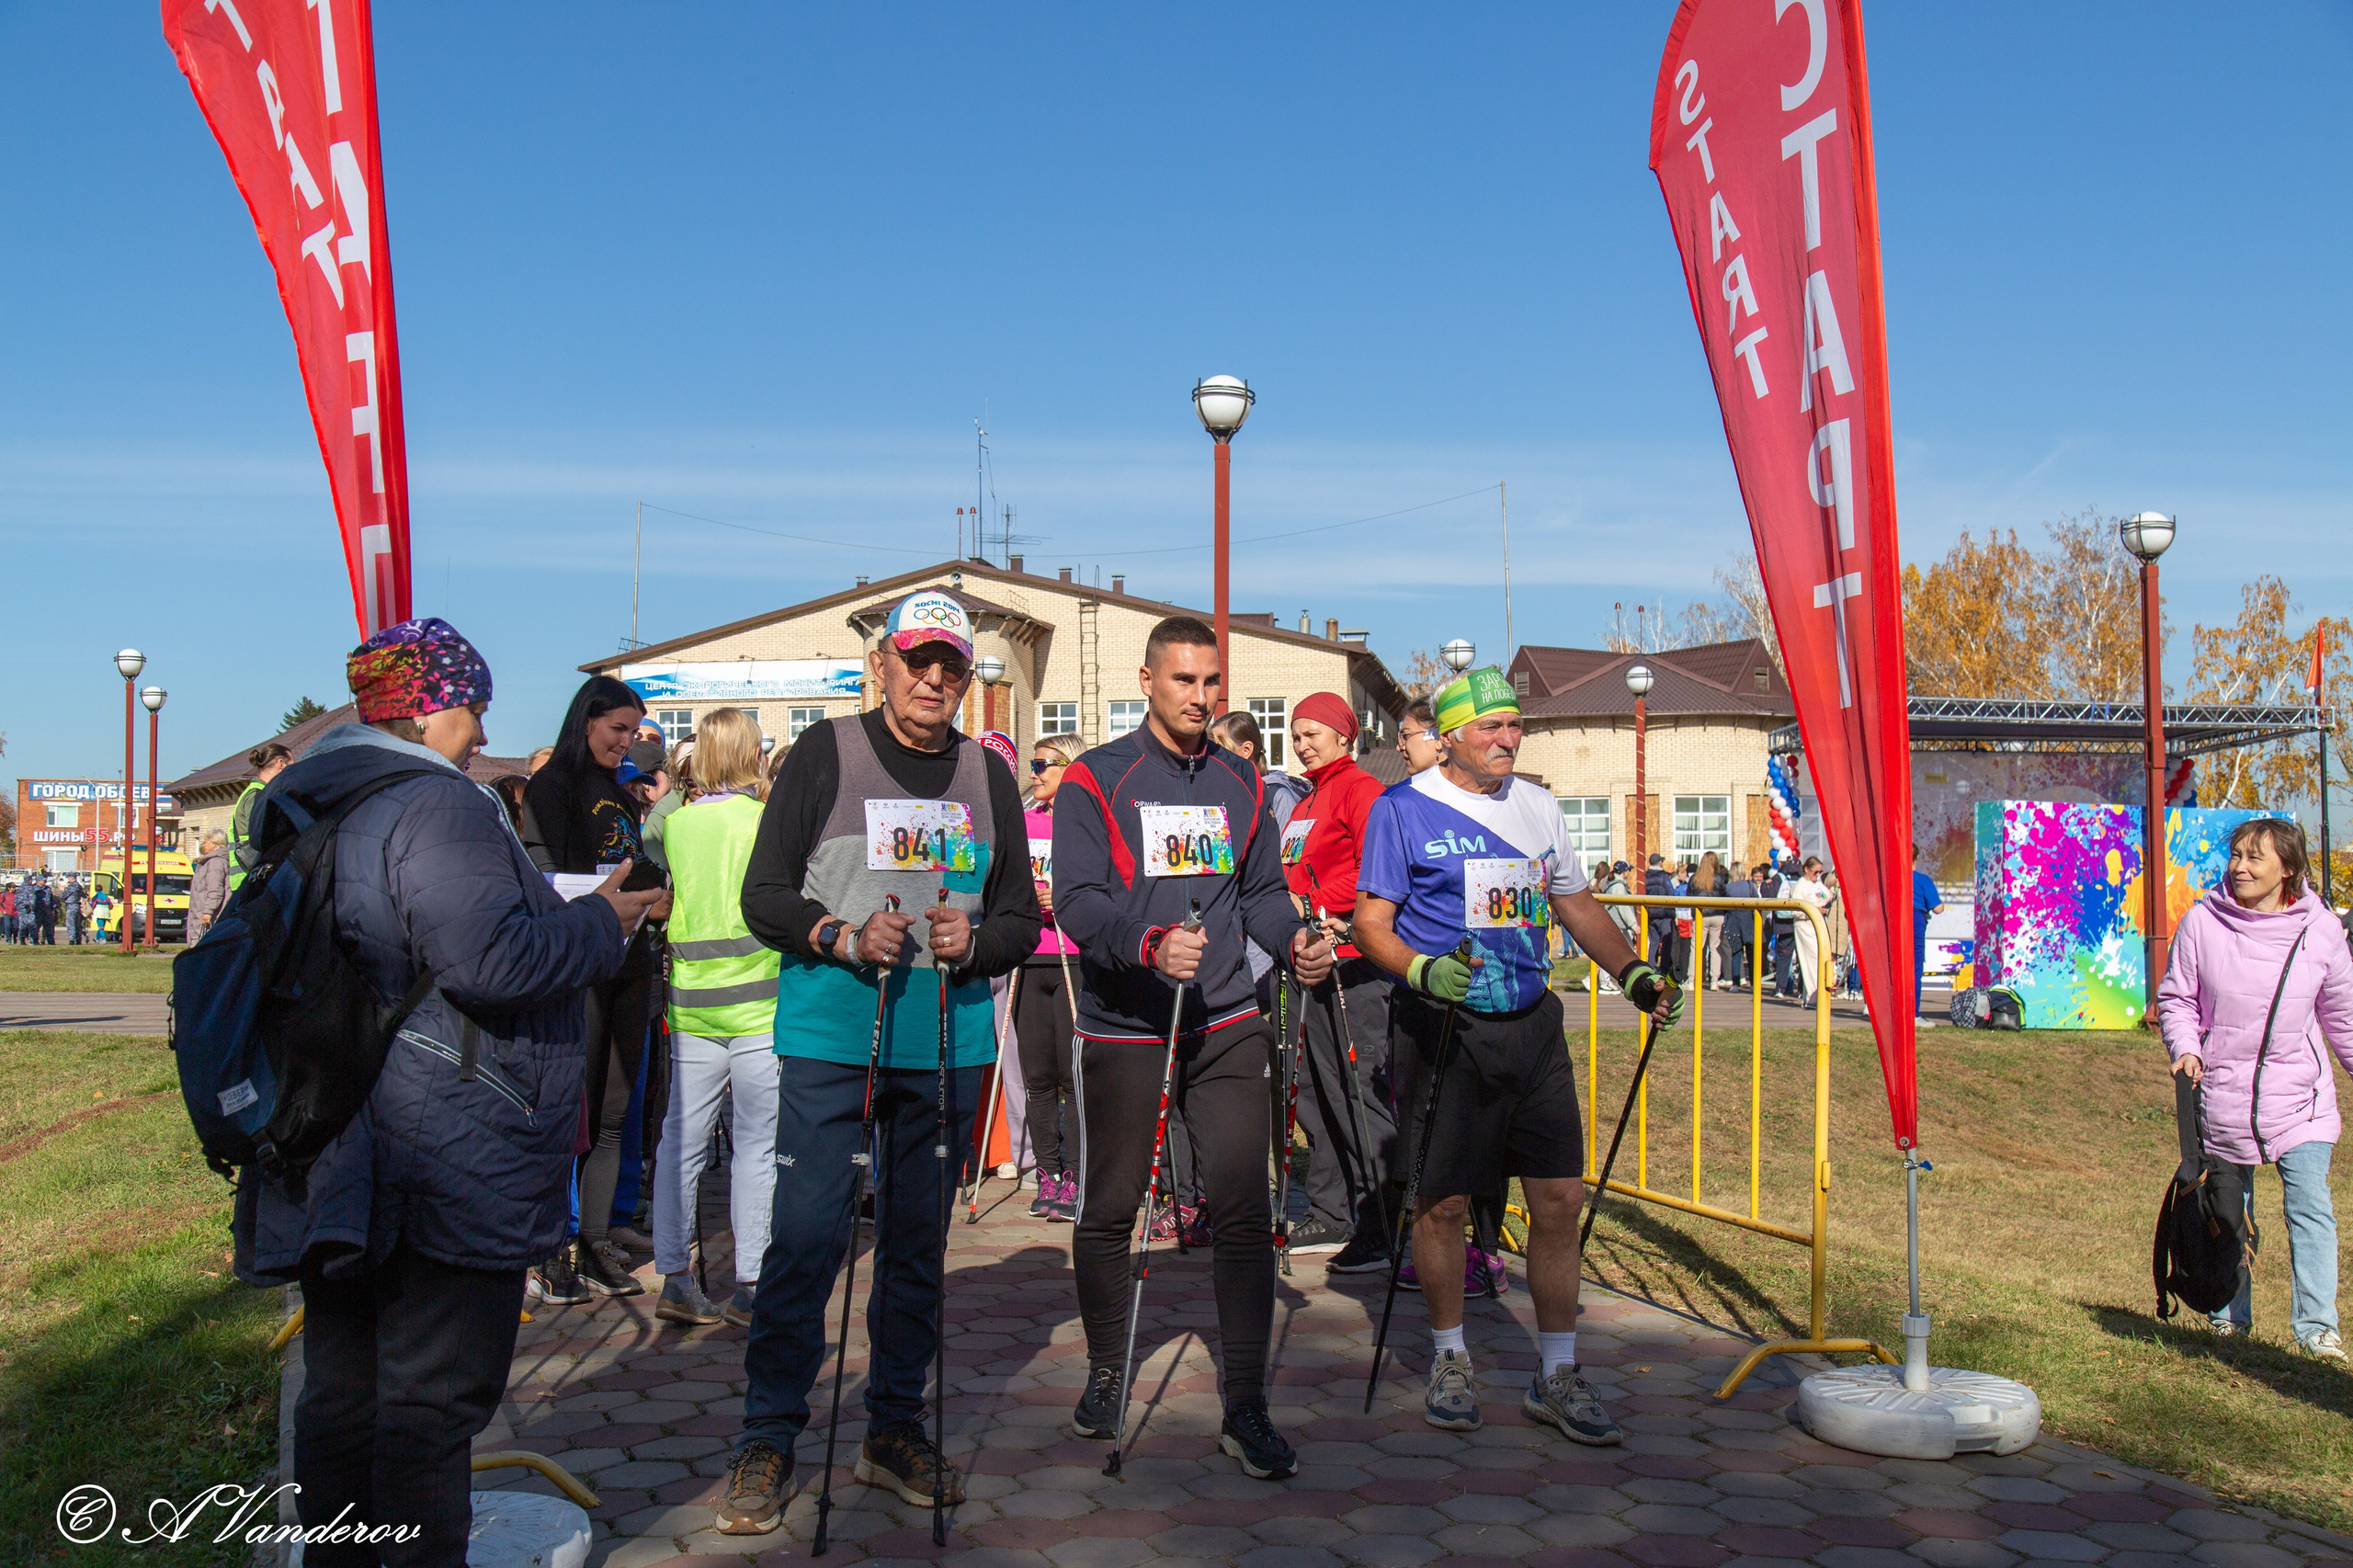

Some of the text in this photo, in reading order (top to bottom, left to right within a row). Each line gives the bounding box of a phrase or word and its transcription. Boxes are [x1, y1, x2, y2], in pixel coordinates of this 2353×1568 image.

[942, 601, 961, 614] 2014
[645, 682, 678, 691] ЦЕНТР
[676, 689, 757, 698] ОПЕРАТИВНОГО
[761, 687, 847, 696] РЕАГИРОВАНИЯ
[1481, 692, 1494, 704] НА
[32, 783, 90, 800] ГОРОД
[892, 826, 948, 862] 841
[1165, 834, 1214, 868] 840
[1488, 887, 1532, 920] 830
[1336, 983, 1347, 1009] LEKI
[871, 1019, 881, 1057] LEKI
